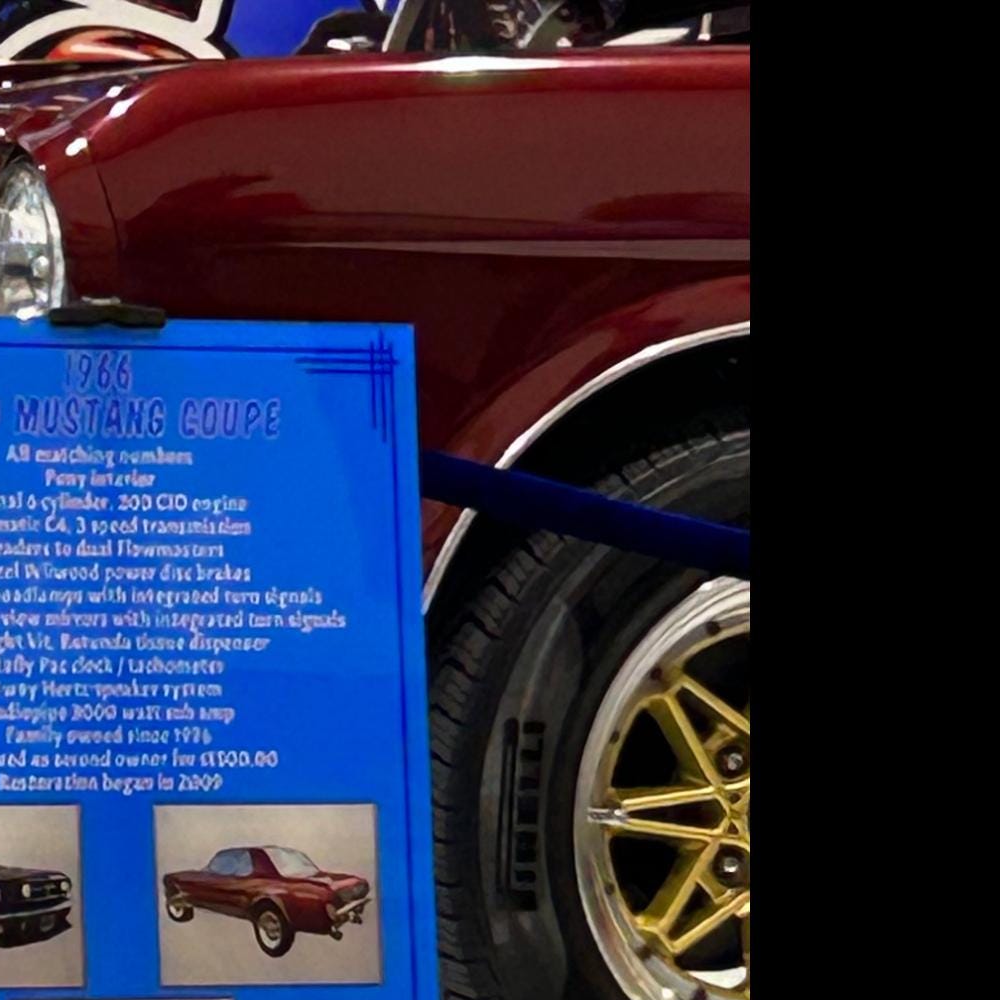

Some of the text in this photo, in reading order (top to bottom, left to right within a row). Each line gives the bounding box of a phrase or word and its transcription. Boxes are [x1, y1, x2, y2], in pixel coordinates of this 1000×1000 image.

[64, 350, 133, 392] 1966
[13, 394, 165, 439] MUSTANG
[179, 396, 280, 440] COUPE
[5, 444, 194, 468] All matching numbers
[45, 468, 156, 489] Pony interior
[191, 494, 249, 516] engine
[75, 516, 86, 534] 3
[91, 515, 138, 537] speed
[142, 516, 252, 536] transmission
[54, 539, 72, 557] to
[76, 537, 113, 557] dual
[104, 564, 157, 585] power
[159, 562, 193, 582] disc
[196, 563, 251, 582] brakes
[87, 584, 127, 604] with
[131, 586, 220, 608] integrated
[224, 587, 260, 604] turn
[265, 587, 323, 609] signals
[0, 607, 41, 626] view
[44, 608, 108, 627] mirrors
[112, 609, 151, 628] with
[154, 609, 244, 632] integrated
[248, 611, 284, 628] turn
[288, 610, 347, 633] signals
[136, 632, 185, 652] tissue
[189, 631, 271, 655] dispenser
[38, 655, 68, 675] Pac
[71, 655, 114, 676] clock
[116, 656, 125, 677] /
[127, 656, 225, 676] tachometer
[94, 678, 159, 701] speaker
[162, 681, 223, 701] system
[122, 703, 162, 722] watt
[165, 702, 195, 722] sub
[198, 706, 236, 725] amp
[5, 725, 63, 748] Family
[66, 725, 123, 744] owned
[127, 726, 169, 745] since
[30, 751, 50, 768] as
[53, 749, 111, 768] second
[115, 751, 168, 769] owner
[171, 748, 196, 768] for
[102, 773, 154, 797] began
[157, 772, 174, 791] in
[177, 773, 224, 793] 2009
